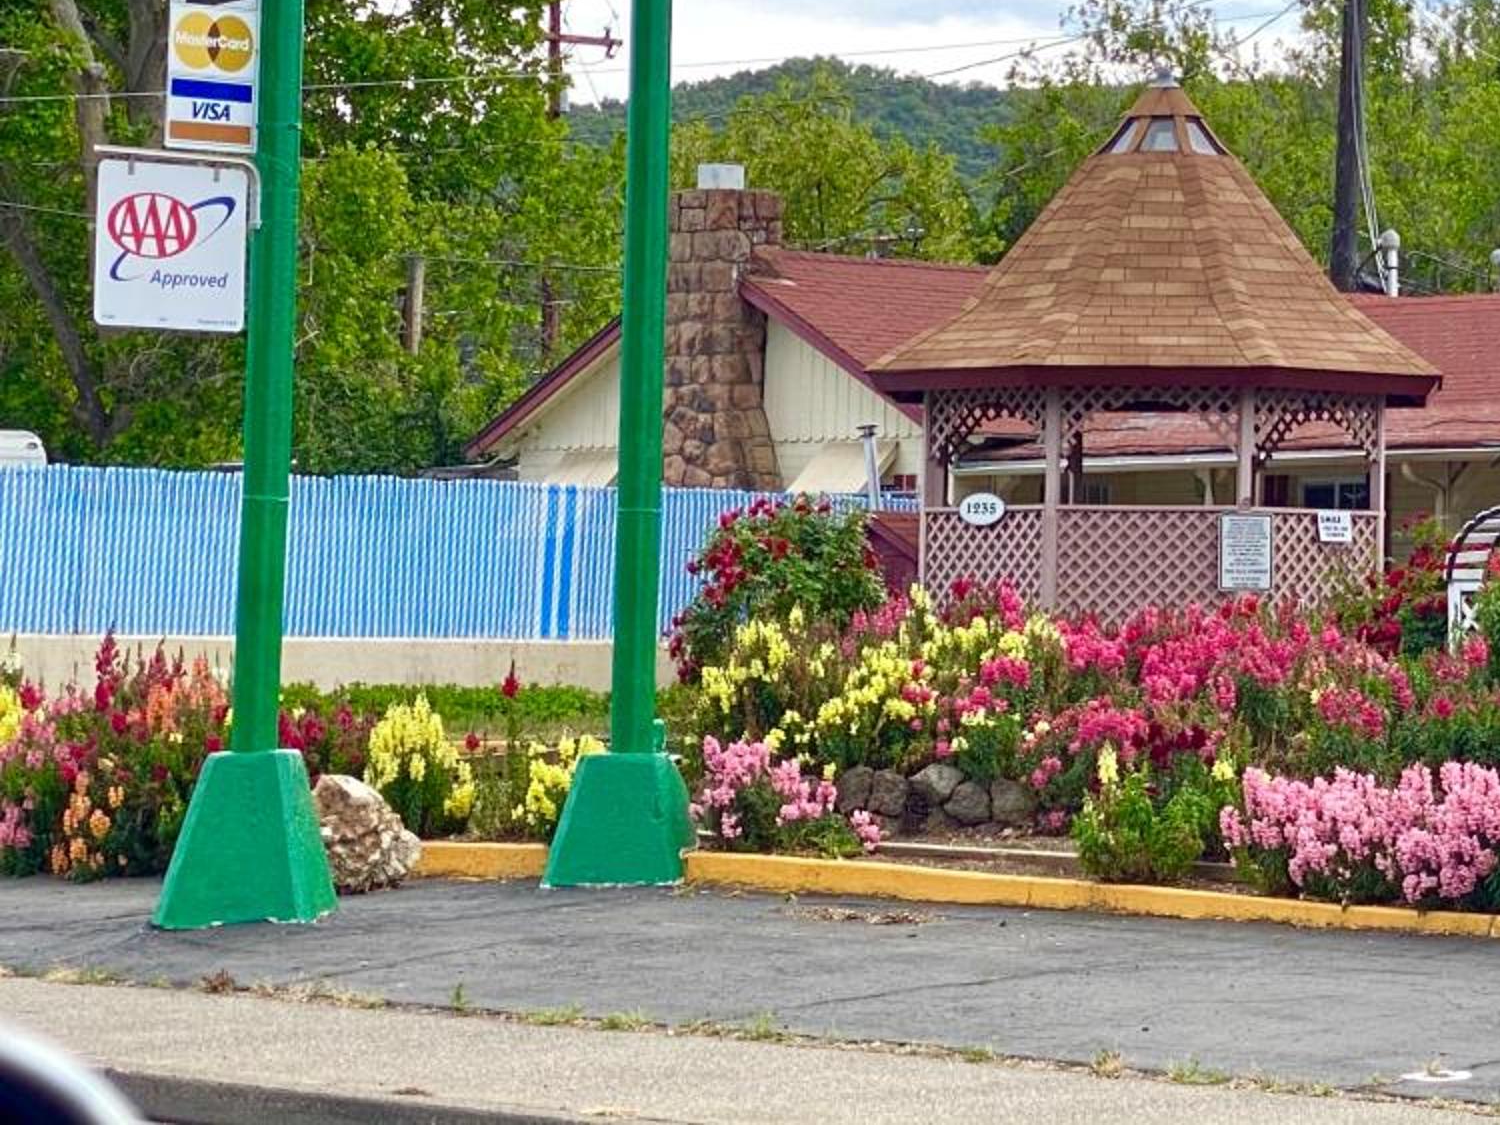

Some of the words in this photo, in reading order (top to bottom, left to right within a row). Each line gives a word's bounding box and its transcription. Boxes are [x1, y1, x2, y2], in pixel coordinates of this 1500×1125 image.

[192, 101, 231, 121] VISA
[113, 193, 192, 259] AAA
[149, 269, 229, 290] Approved
[967, 501, 997, 515] 1235
